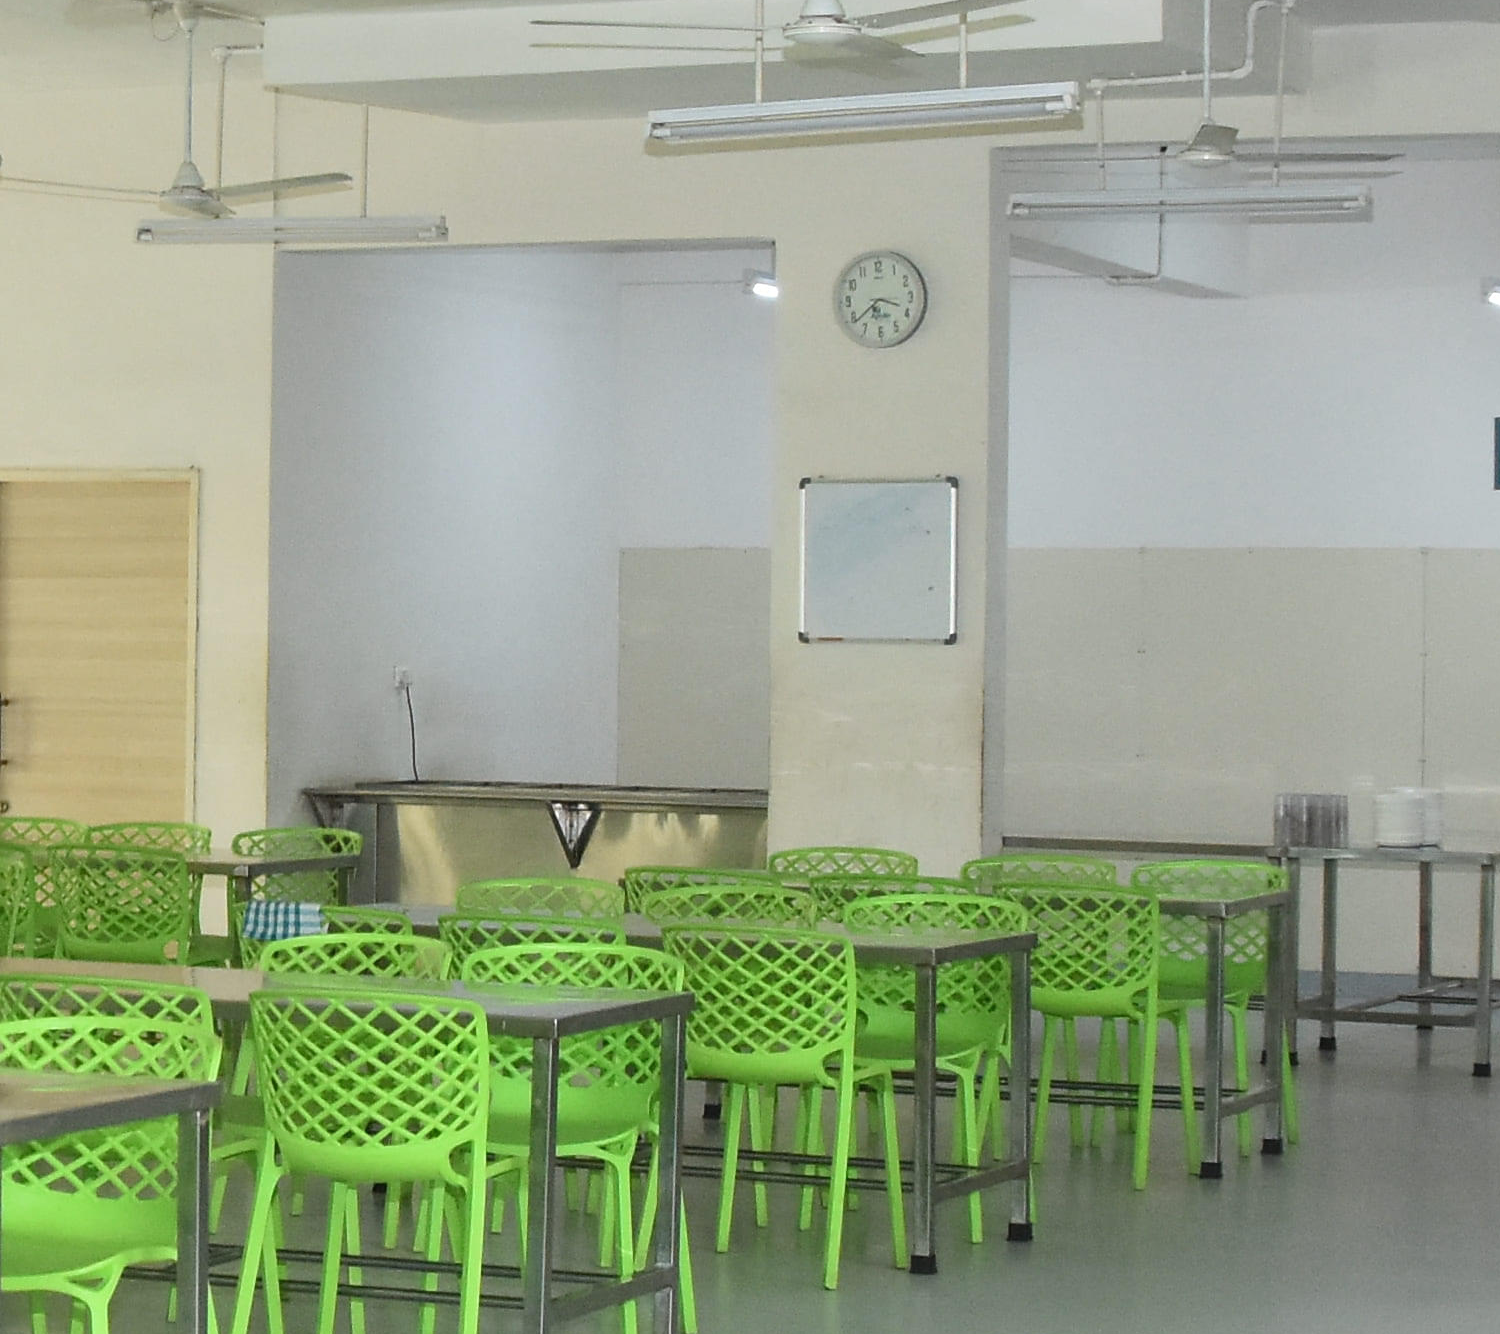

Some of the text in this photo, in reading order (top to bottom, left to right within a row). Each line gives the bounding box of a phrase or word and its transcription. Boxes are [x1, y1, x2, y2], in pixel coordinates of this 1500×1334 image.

[859, 266, 867, 278] 11
[874, 261, 883, 273] 12
[848, 279, 857, 291] 10
